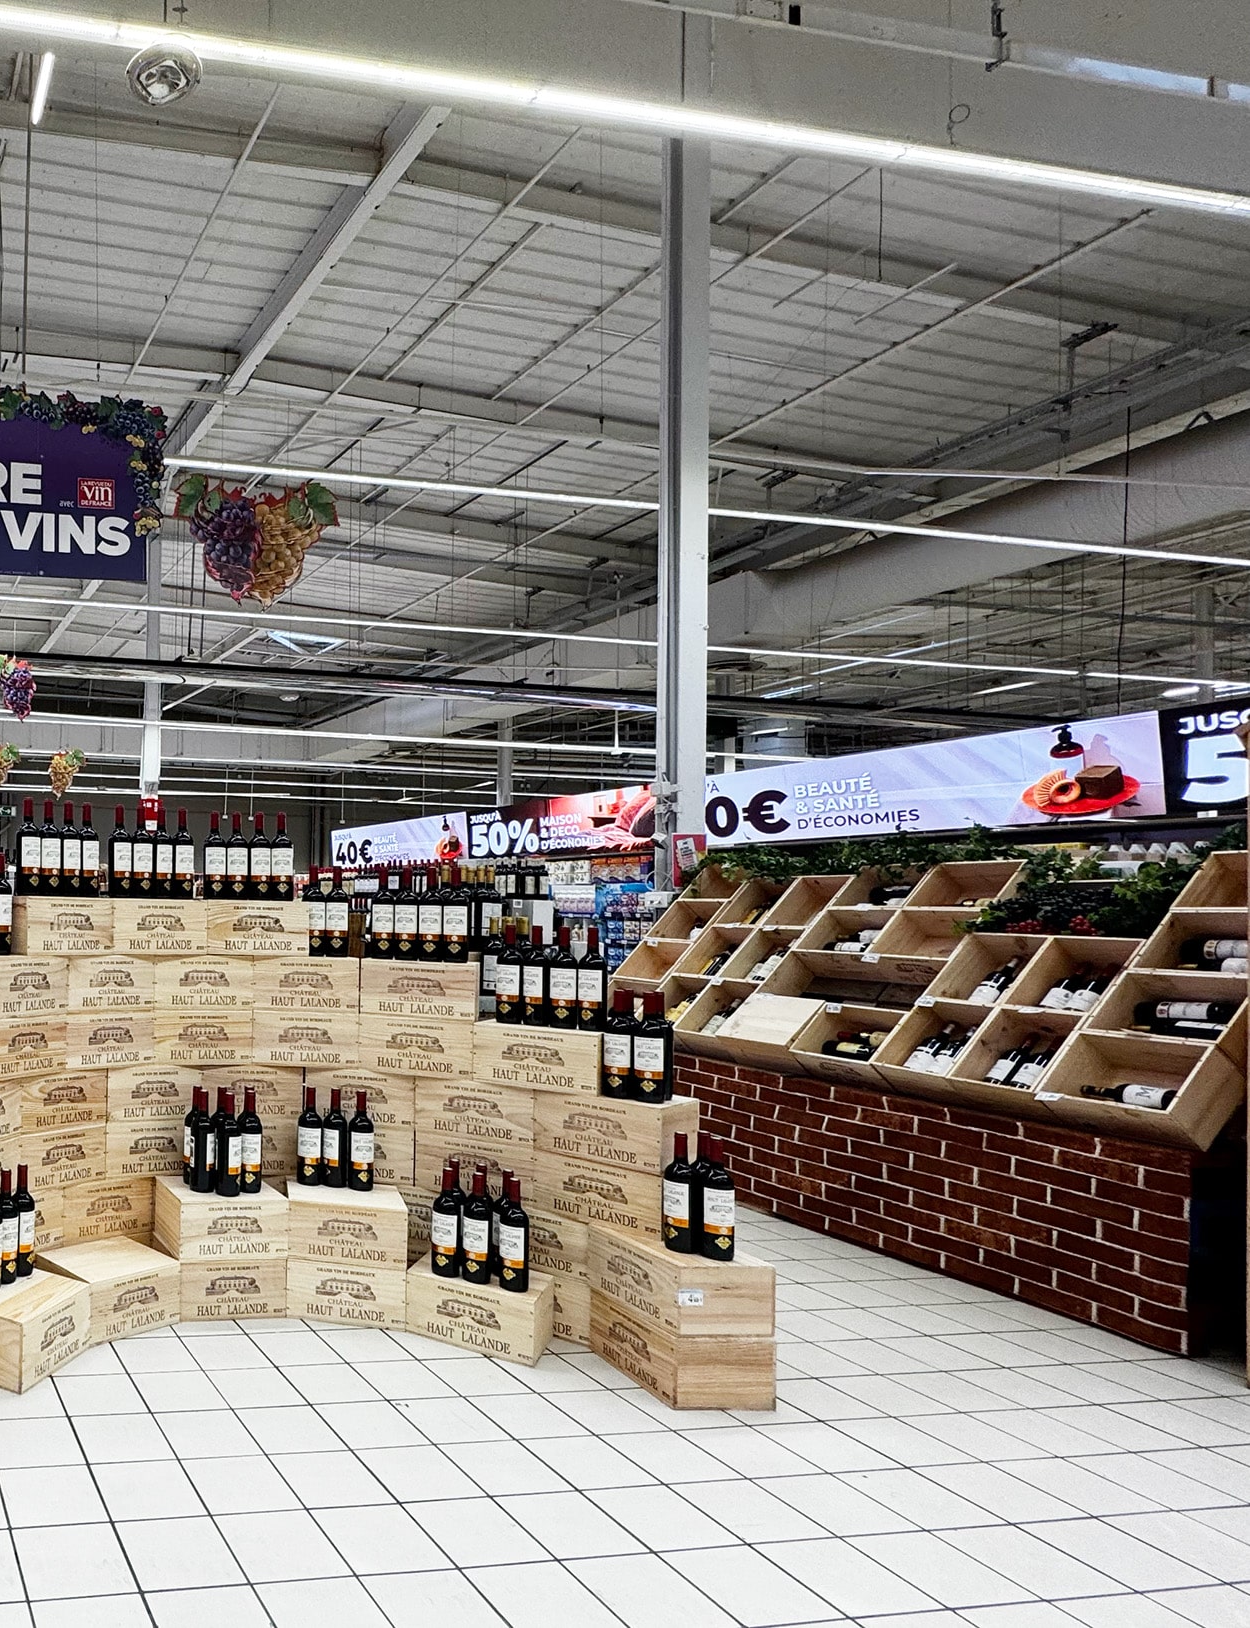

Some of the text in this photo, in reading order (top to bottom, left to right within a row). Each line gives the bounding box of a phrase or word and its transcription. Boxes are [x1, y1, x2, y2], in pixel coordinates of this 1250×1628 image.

[0, 510, 131, 556] VINS
[1182, 734, 1249, 803] 5
[794, 772, 872, 798] BEAUTÉ
[796, 789, 880, 814] & SANTÉ
[470, 811, 501, 823] JUSQU'À
[540, 814, 582, 827] MAISON
[705, 790, 791, 837] 0€
[798, 809, 920, 830] D'ÉCONOMIES
[472, 818, 539, 857] 50%
[540, 826, 579, 838] & DECO
[541, 835, 605, 849] D'ÉCONOMIES
[336, 839, 373, 865] 40€
[43, 940, 100, 950] HAUT LALANDE
[130, 939, 191, 950] HAUT LALANDE
[225, 940, 292, 951] HAUT LALANDE
[3, 999, 55, 1012] HAUT LALANDE
[82, 995, 141, 1007] HAUT LALANDE
[172, 996, 237, 1005] HAUT LALANDE
[271, 996, 341, 1008] HAUT LALANDE
[379, 1001, 454, 1016] HAUT LALANDE
[82, 1052, 140, 1065] HAUT LALANDE
[170, 1050, 236, 1059] HAUT LALANDE
[270, 1051, 341, 1063] HAUT LALANDE
[1, 1058, 53, 1074] HAUT LALANDE
[377, 1057, 453, 1073] HAUT LALANDE
[493, 1068, 574, 1088] HAUT LALANDE
[36, 1110, 92, 1127] HAUT LALANDE
[124, 1104, 186, 1117] HAUT LALANDE
[434, 1120, 512, 1140] HAUT LALANDE
[553, 1137, 637, 1164] HAUT LALANDE
[35, 1169, 91, 1187] HAUT LALANDE
[554, 1198, 638, 1228] HAUT LALANDE
[79, 1219, 138, 1237] HAUT LALANDE
[199, 1243, 270, 1255] HAUT LALANDE
[308, 1244, 386, 1262] HAUT LALANDE
[601, 1278, 621, 1298] HAUT
[624, 1290, 660, 1320] LALANDE
[197, 1304, 268, 1316] HAUT LALANDE
[306, 1304, 385, 1322] HAUT LALANDE
[106, 1314, 165, 1336] HAUT LALANDE
[427, 1322, 510, 1354] HAUT LALANDE
